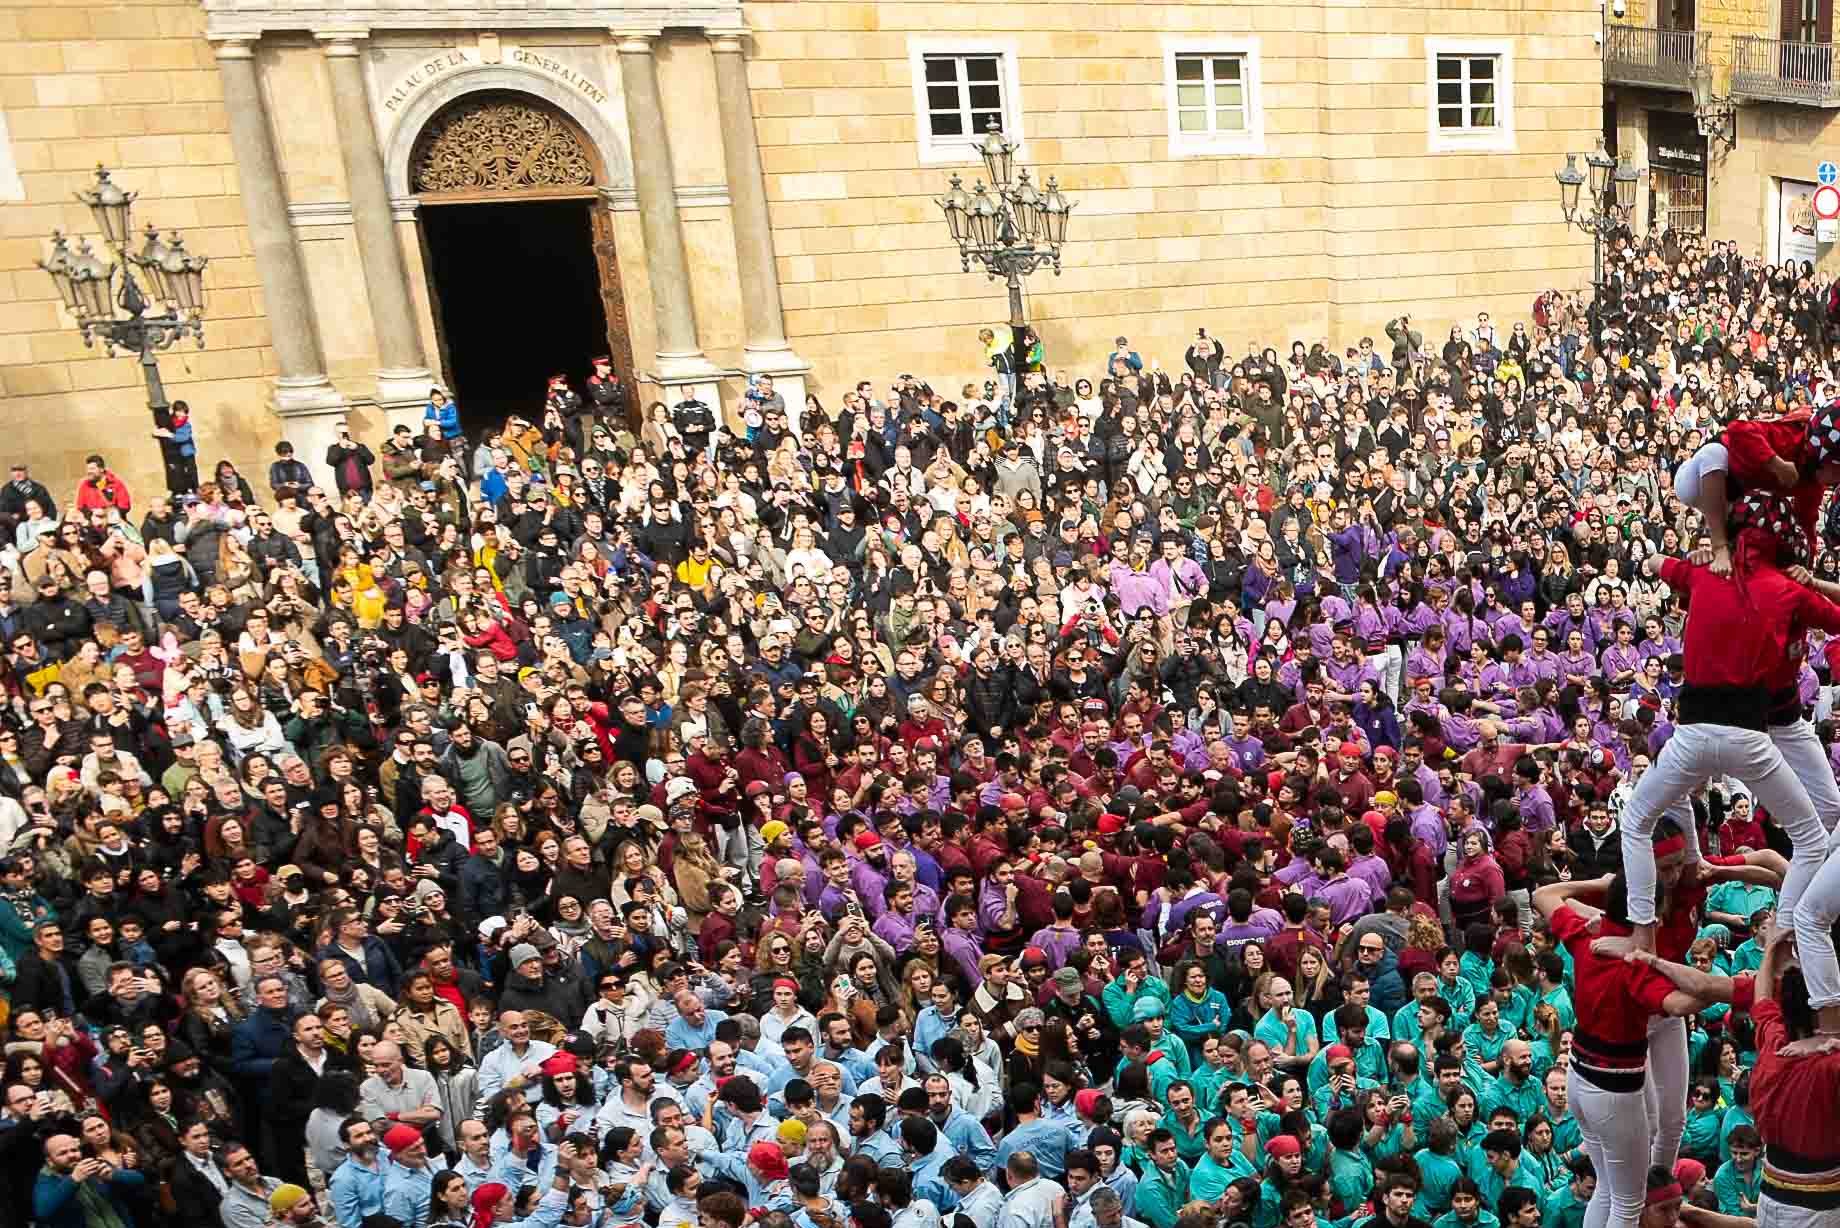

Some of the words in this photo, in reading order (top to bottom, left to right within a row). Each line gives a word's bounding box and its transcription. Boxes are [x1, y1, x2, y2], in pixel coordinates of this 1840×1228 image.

[385, 71, 422, 112] PALAU
[424, 58, 446, 75] DE
[448, 51, 471, 66] LA
[512, 49, 608, 105] GENERALITAT
